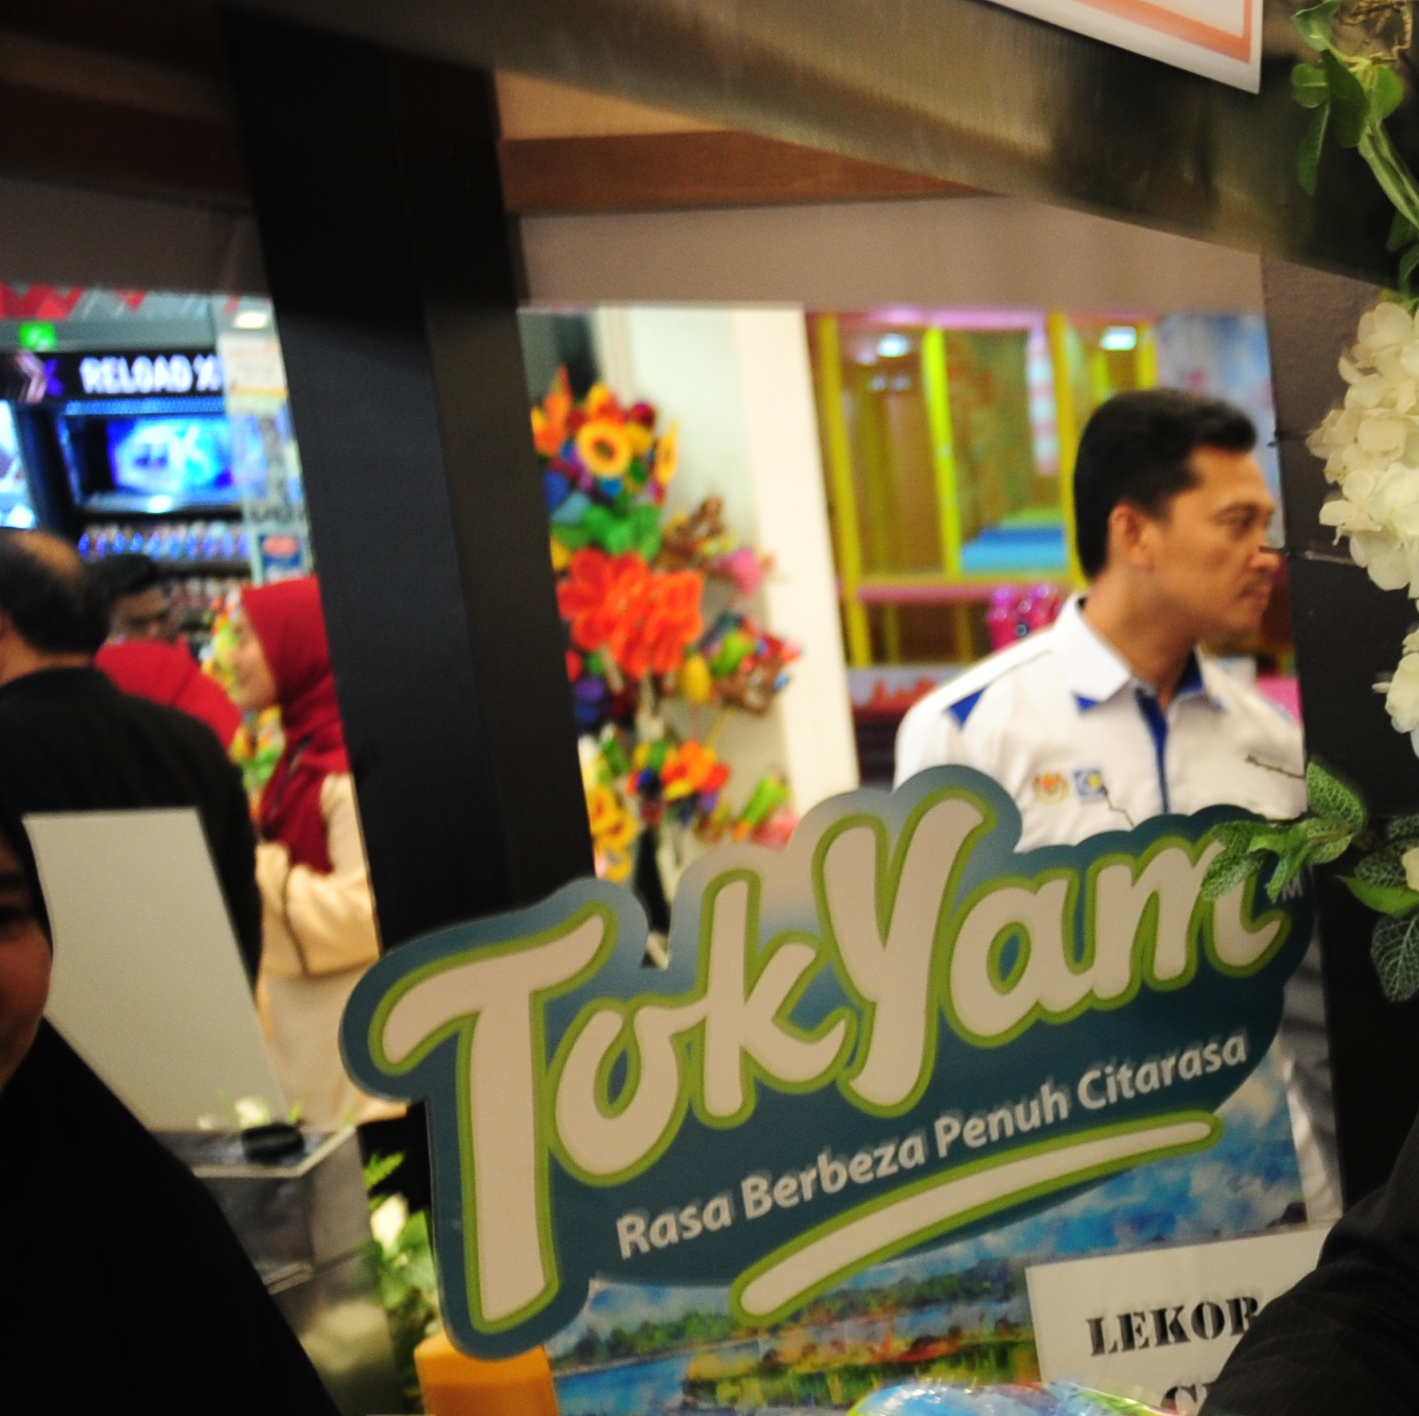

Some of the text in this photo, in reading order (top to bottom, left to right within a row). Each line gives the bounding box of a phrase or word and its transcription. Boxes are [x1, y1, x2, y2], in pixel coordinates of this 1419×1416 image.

[617, 1031, 1251, 1259] Rasa Berbeza Penuh Citarasa
